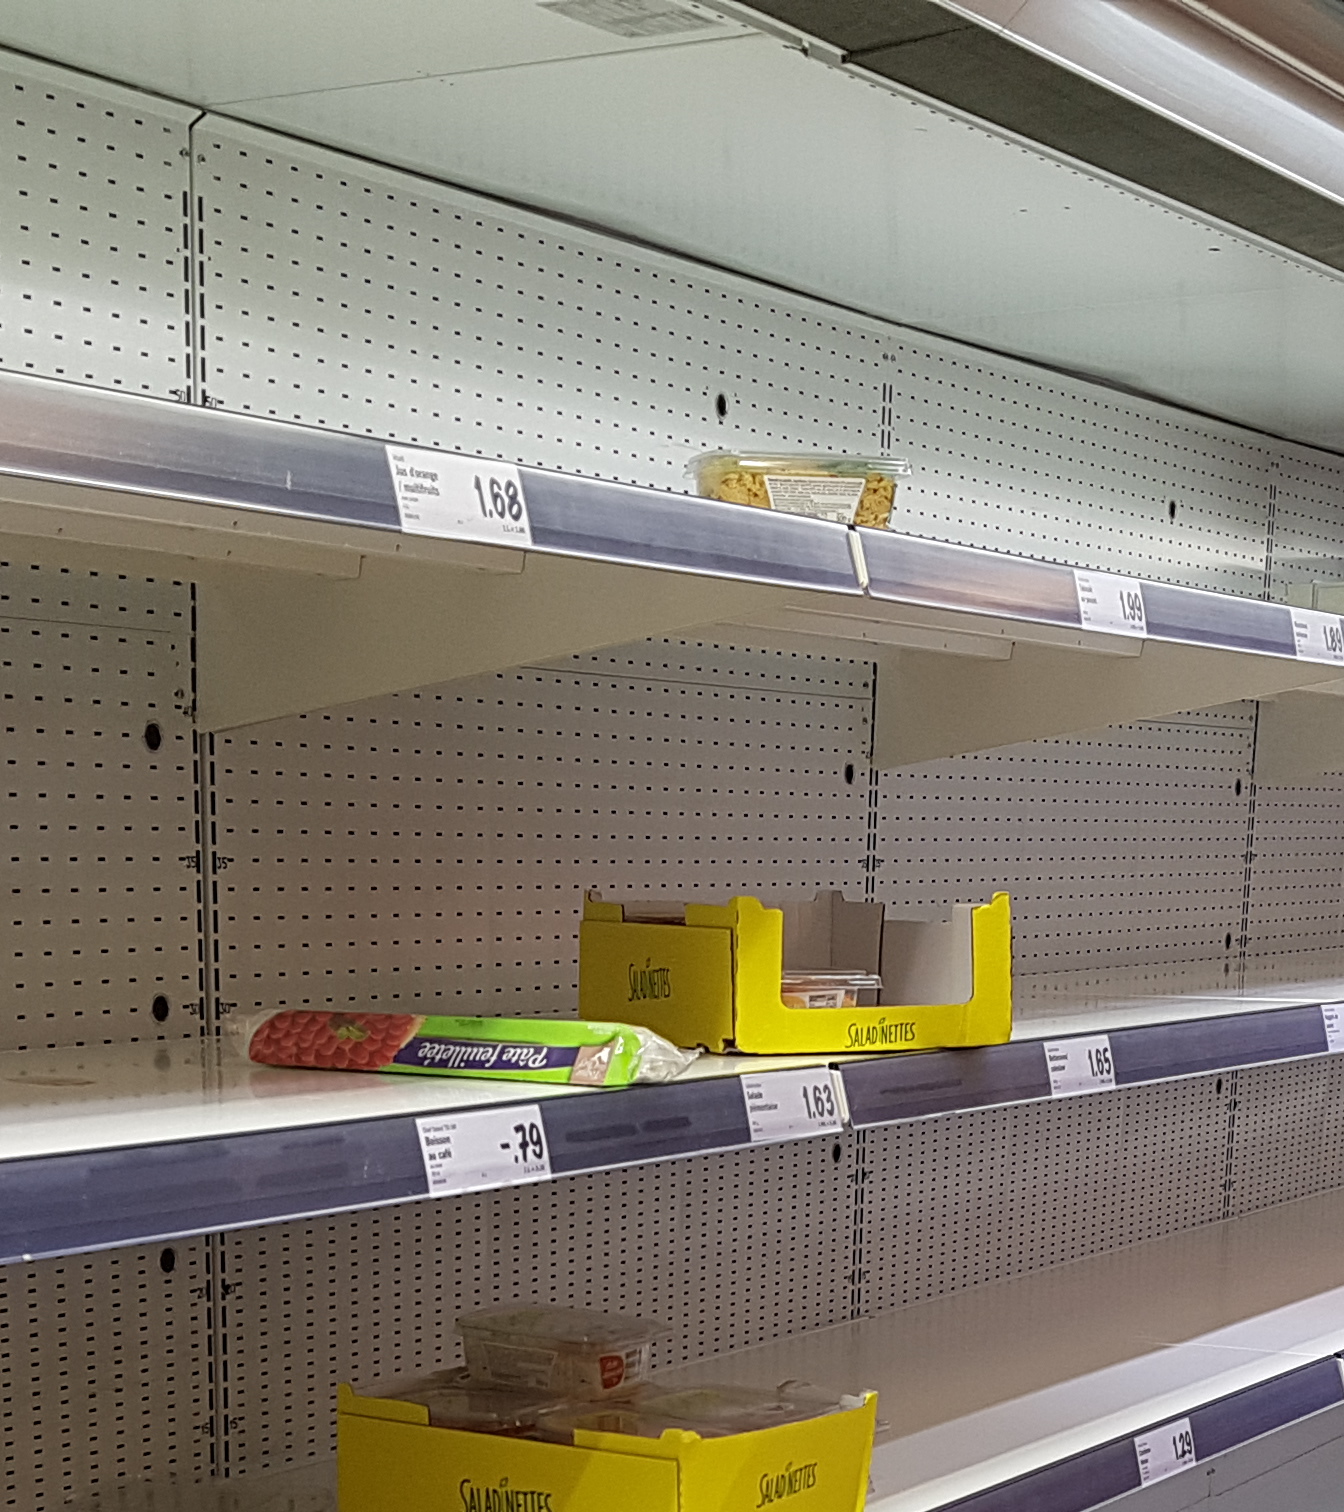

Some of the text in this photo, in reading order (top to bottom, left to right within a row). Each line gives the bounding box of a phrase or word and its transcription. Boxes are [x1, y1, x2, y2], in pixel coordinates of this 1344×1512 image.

[474, 475, 522, 522] 1.68
[1119, 590, 1143, 621] 1.99
[417, 1040, 548, 1072] Pâte feuilletée
[803, 1084, 835, 1119] 1.63
[1173, 1431, 1192, 1460] 1.29
